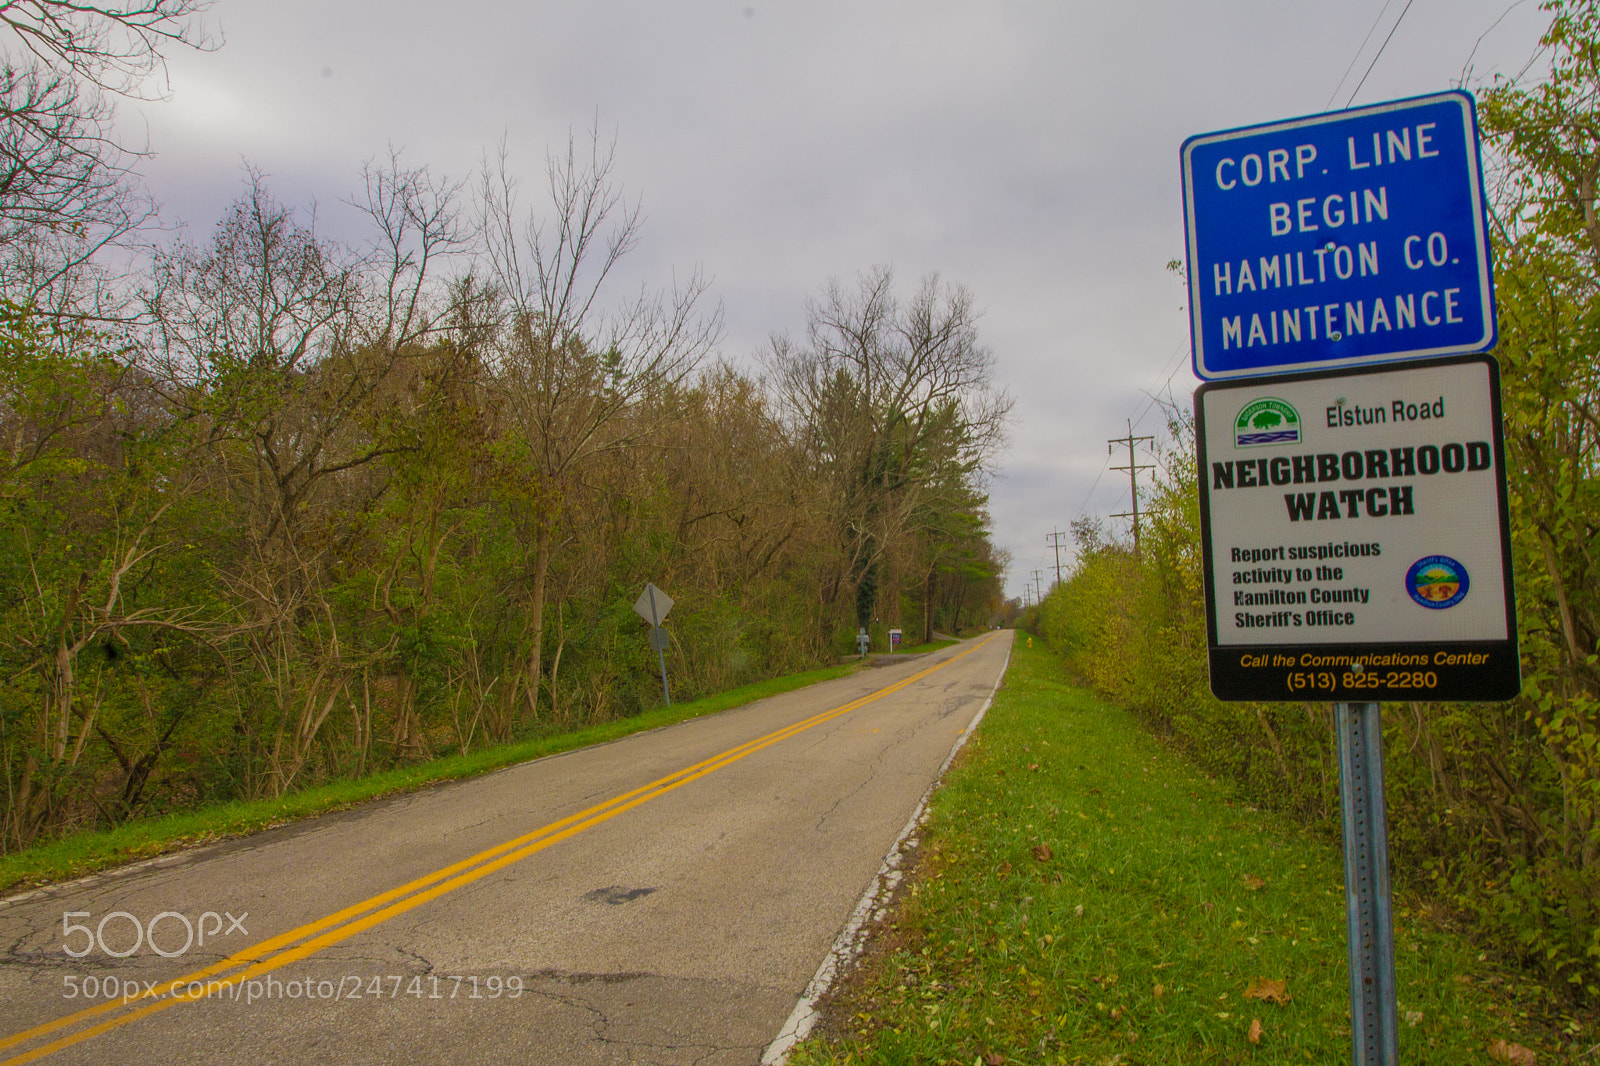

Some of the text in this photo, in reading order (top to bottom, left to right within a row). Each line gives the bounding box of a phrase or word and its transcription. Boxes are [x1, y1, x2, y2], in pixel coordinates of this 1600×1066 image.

[1215, 122, 1440, 191] CORP. LINE
[1269, 186, 1389, 237] BEGIN
[1213, 231, 1460, 296] HAMILTON CO.
[1221, 287, 1464, 350] MAINTENANCE
[1325, 396, 1445, 428] Elstun Road
[1212, 441, 1492, 490] NEIGHBORHOOD
[1284, 485, 1415, 522] WATCH
[1231, 542, 1381, 563] Report suspicious
[1232, 565, 1343, 585] activity to the
[1310, 587, 1370, 605] County
[1235, 610, 1355, 628] Sheriff's Office
[1240, 651, 1490, 668] Call the Communications Center
[1287, 671, 1438, 692] (513) 825-2280
